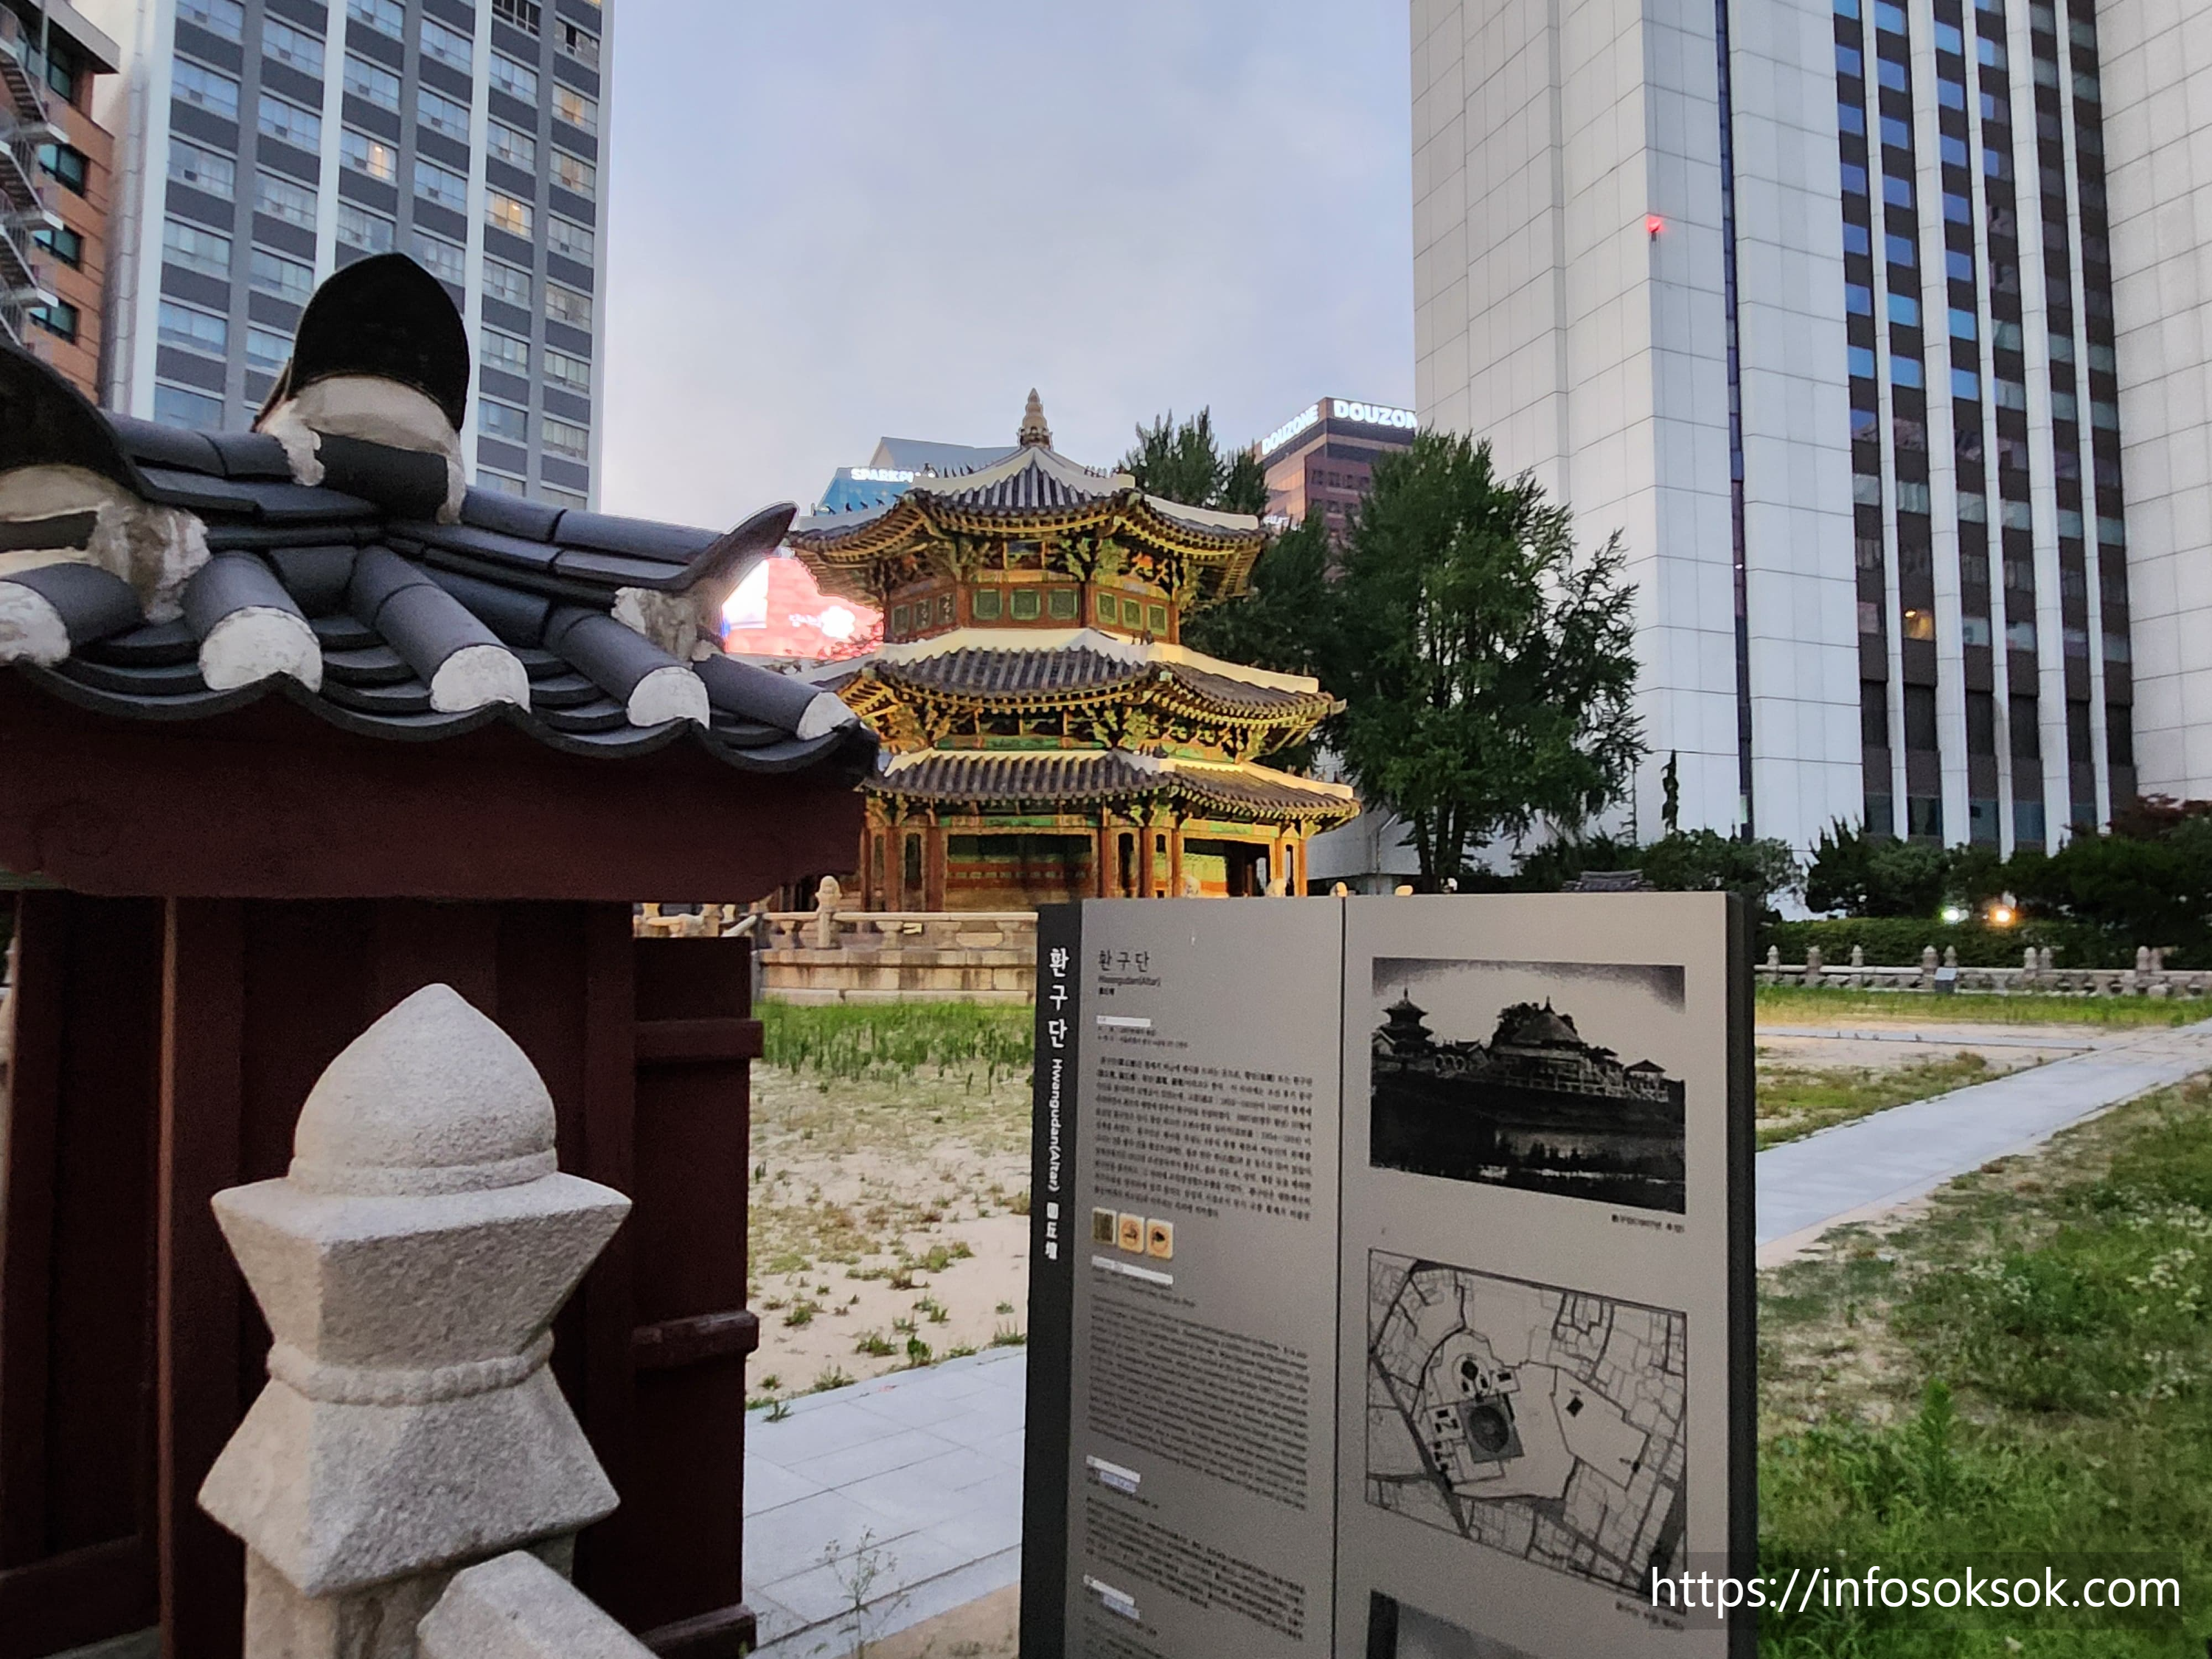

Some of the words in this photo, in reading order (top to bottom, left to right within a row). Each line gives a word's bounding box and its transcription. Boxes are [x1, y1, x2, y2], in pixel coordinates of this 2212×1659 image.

[1262, 404, 1319, 456] DOUZONE
[1048, 947, 1070, 1048] 환구단
[1048, 1058, 1063, 1192] Hwangudan(Altar)
